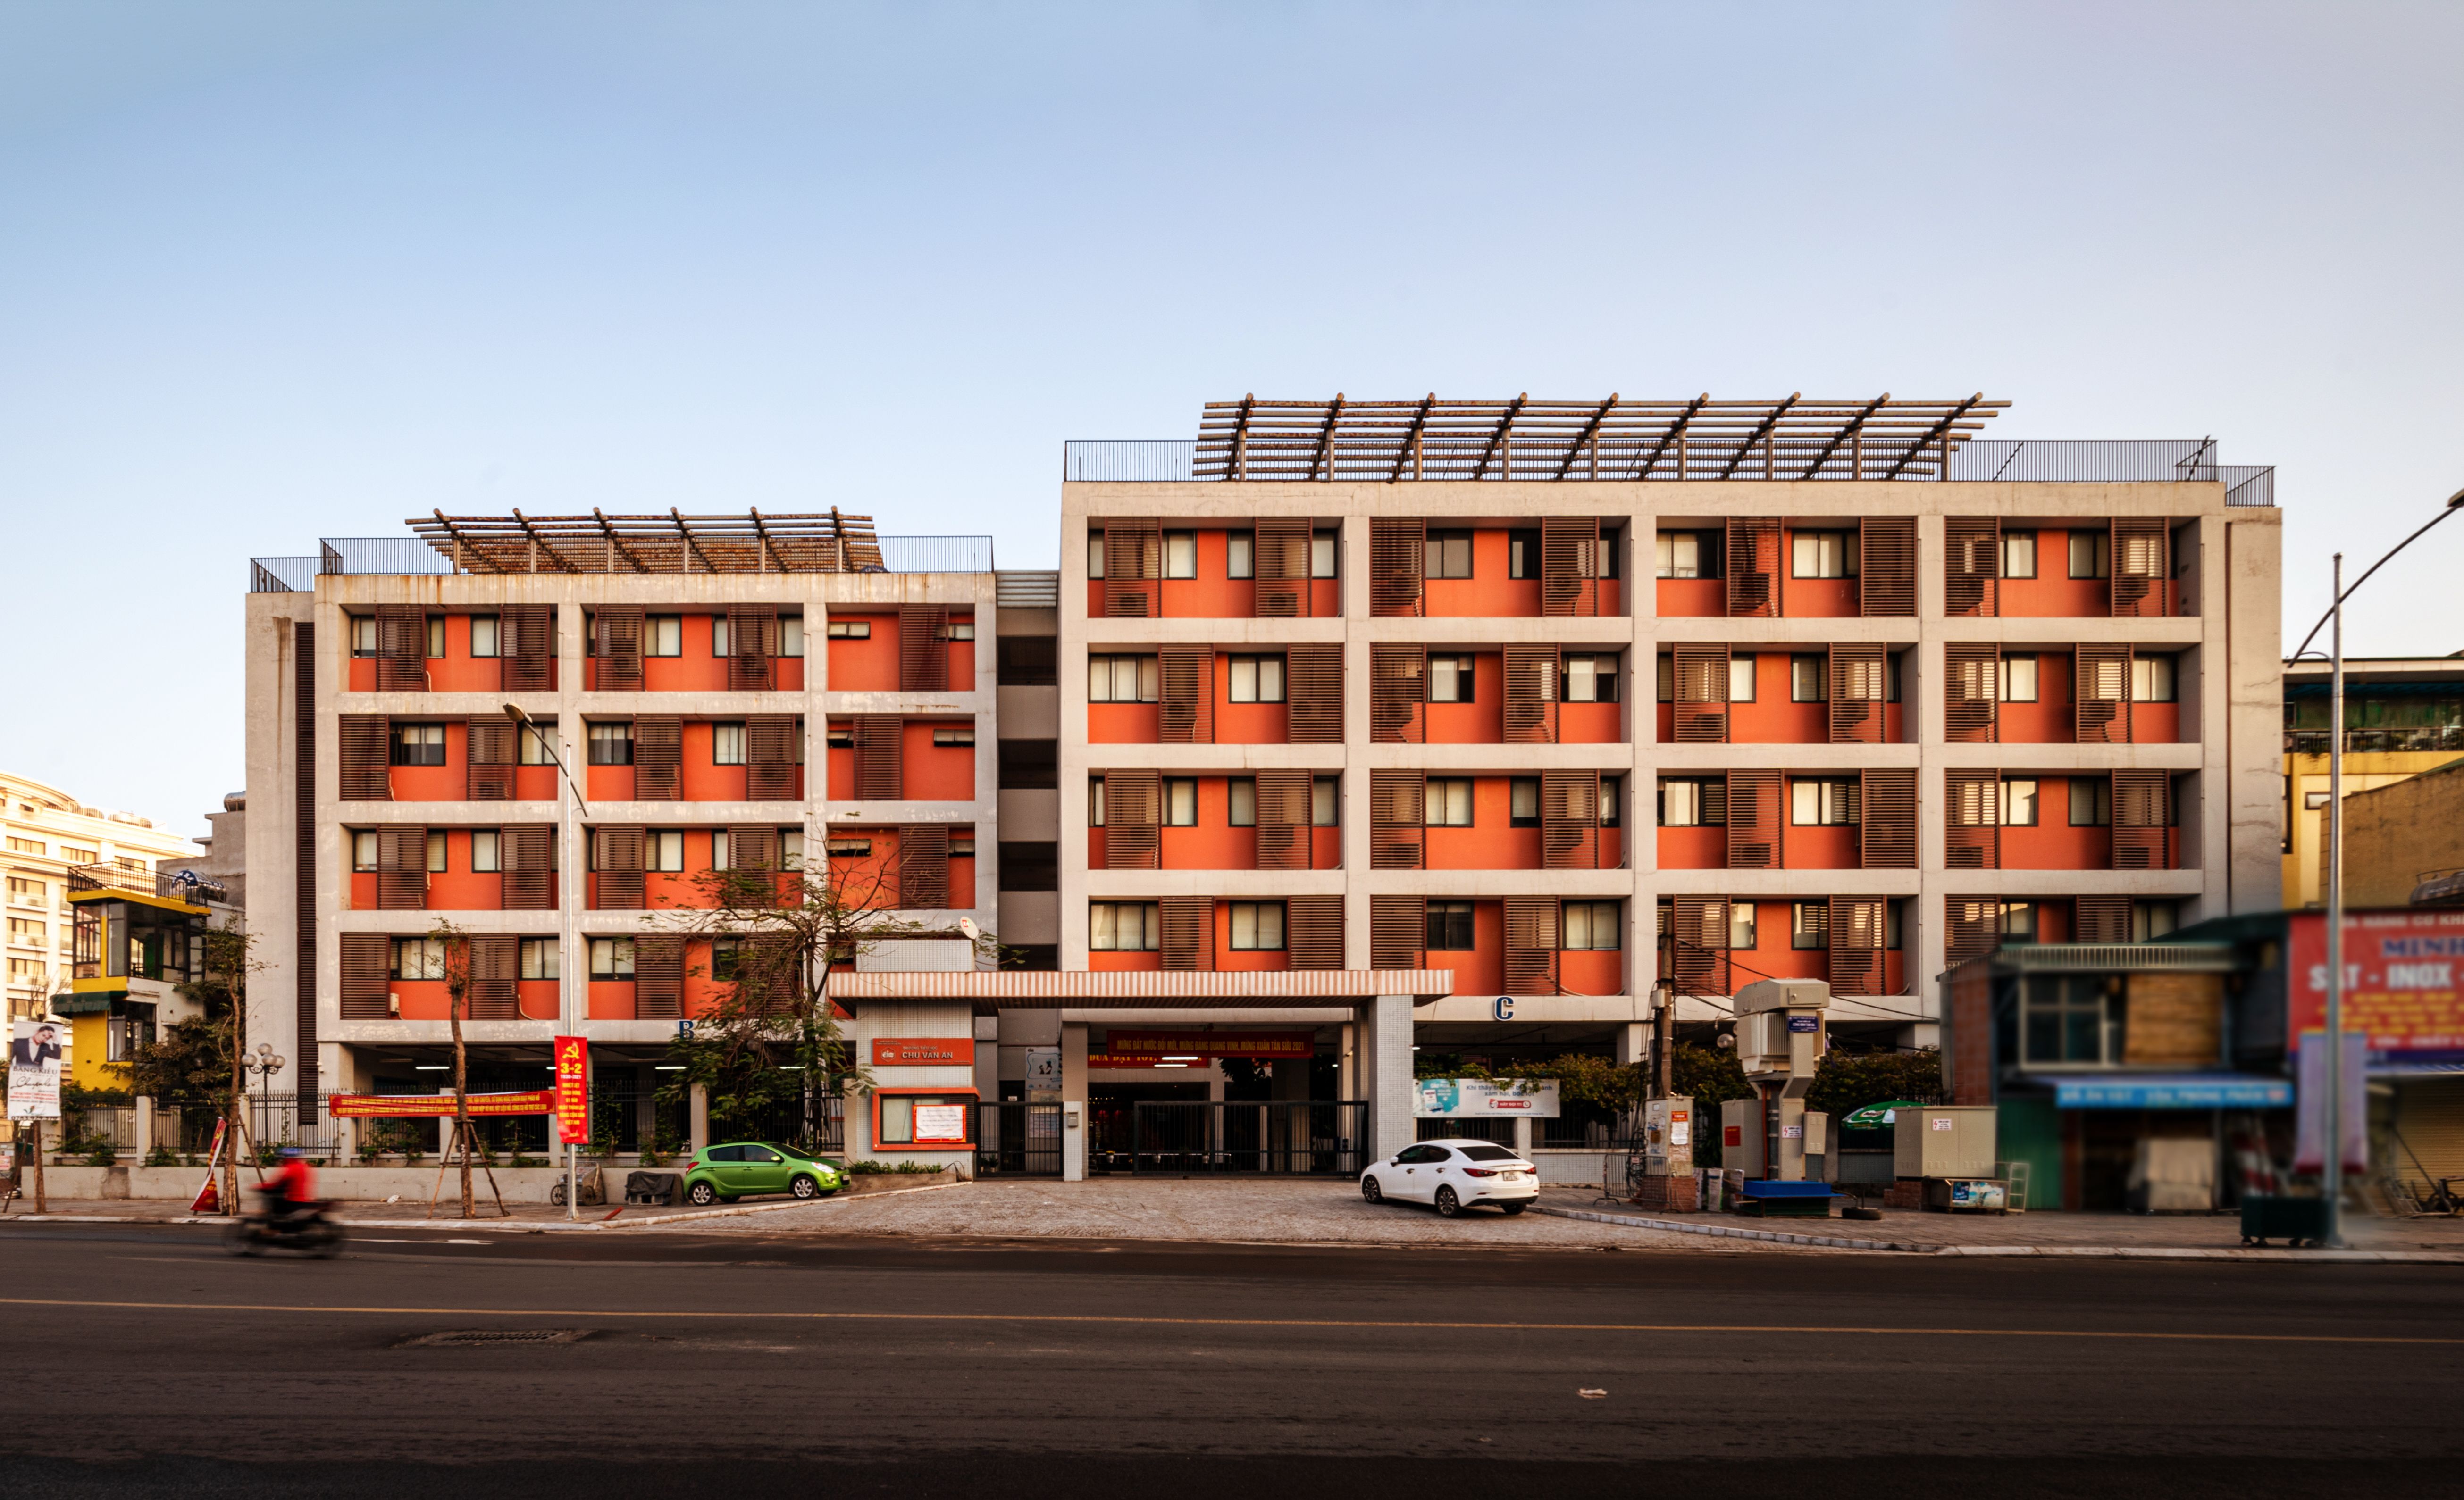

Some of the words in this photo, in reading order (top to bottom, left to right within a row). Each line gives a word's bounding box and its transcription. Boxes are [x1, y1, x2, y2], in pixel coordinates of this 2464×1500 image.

[2309, 964, 2361, 990] ST
[2388, 962, 2453, 989] INOX
[1495, 996, 1515, 1021] C
[679, 1019, 694, 1041] B
[1209, 1041, 1225, 1051] QUANG
[1257, 1039, 1270, 1050] XUÂN
[1292, 1041, 1304, 1050] 2021
[922, 1050, 939, 1058] VĂN
[560, 1063, 582, 1074] 3-2
